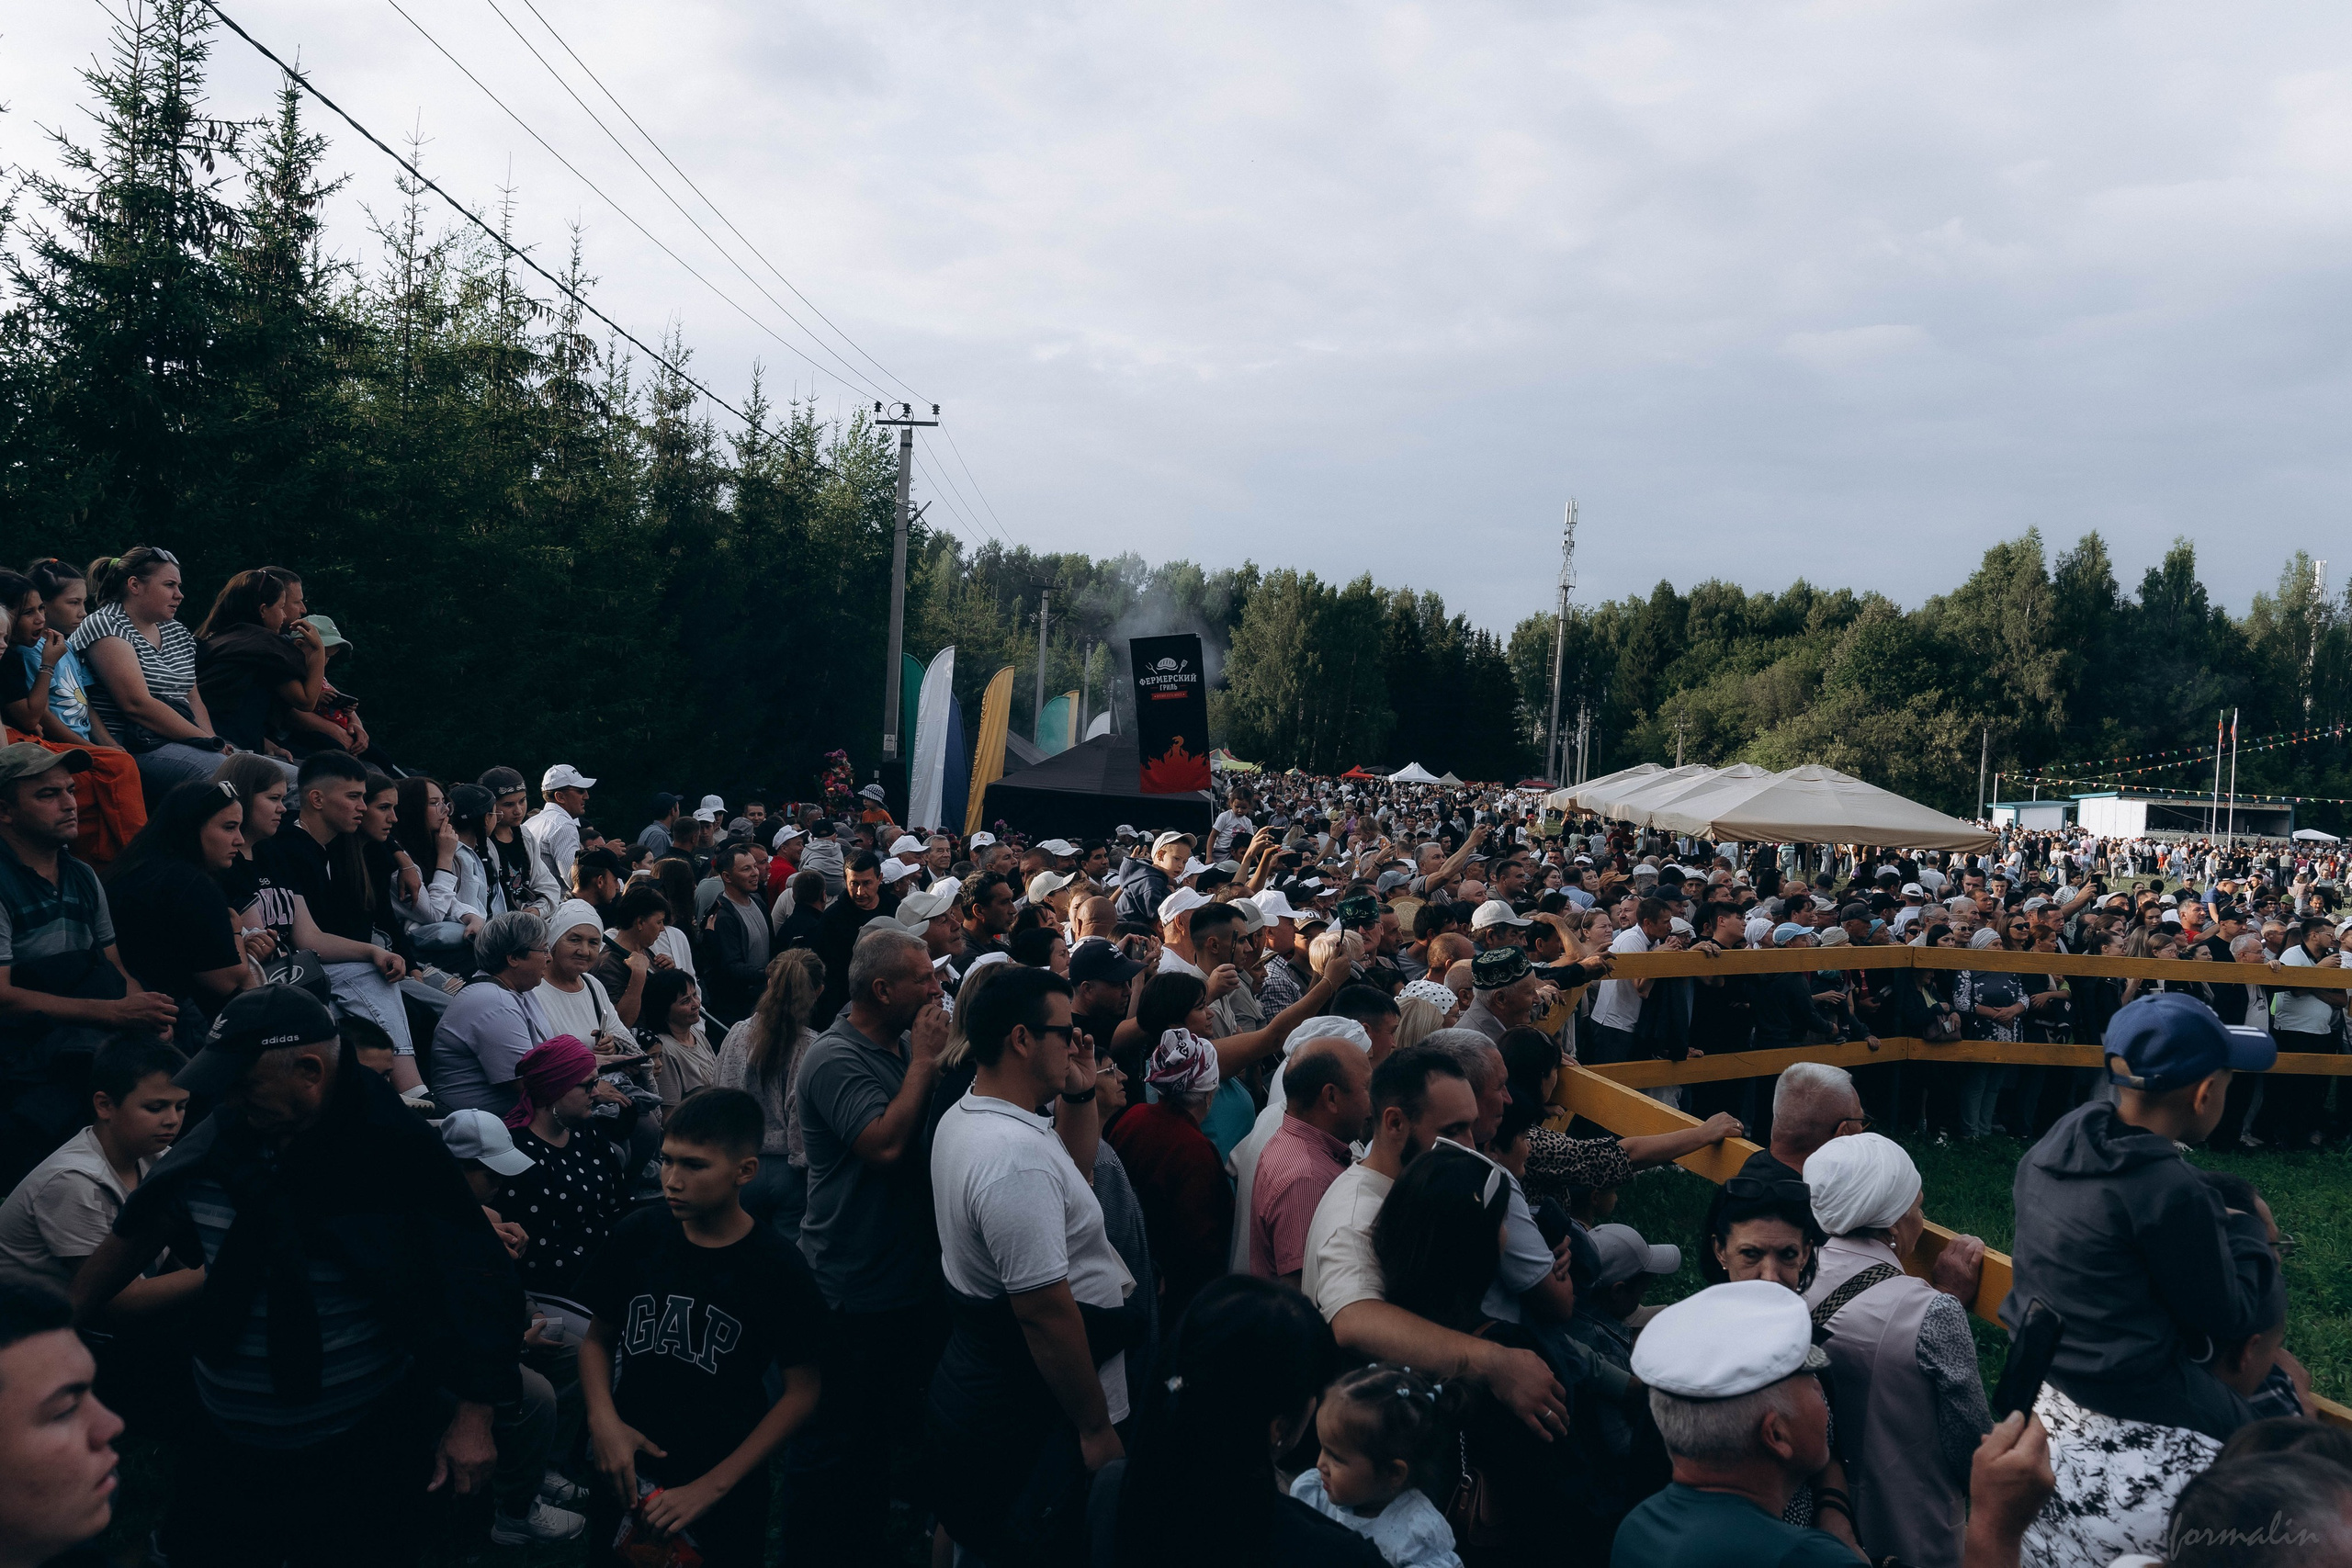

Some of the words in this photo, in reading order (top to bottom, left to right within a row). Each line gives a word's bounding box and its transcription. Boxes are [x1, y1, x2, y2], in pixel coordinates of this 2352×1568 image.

[1139, 673, 1197, 685] ФЕРМЕРСКИЙ
[261, 1034, 300, 1045] adidas
[625, 1294, 742, 1375] GAP
